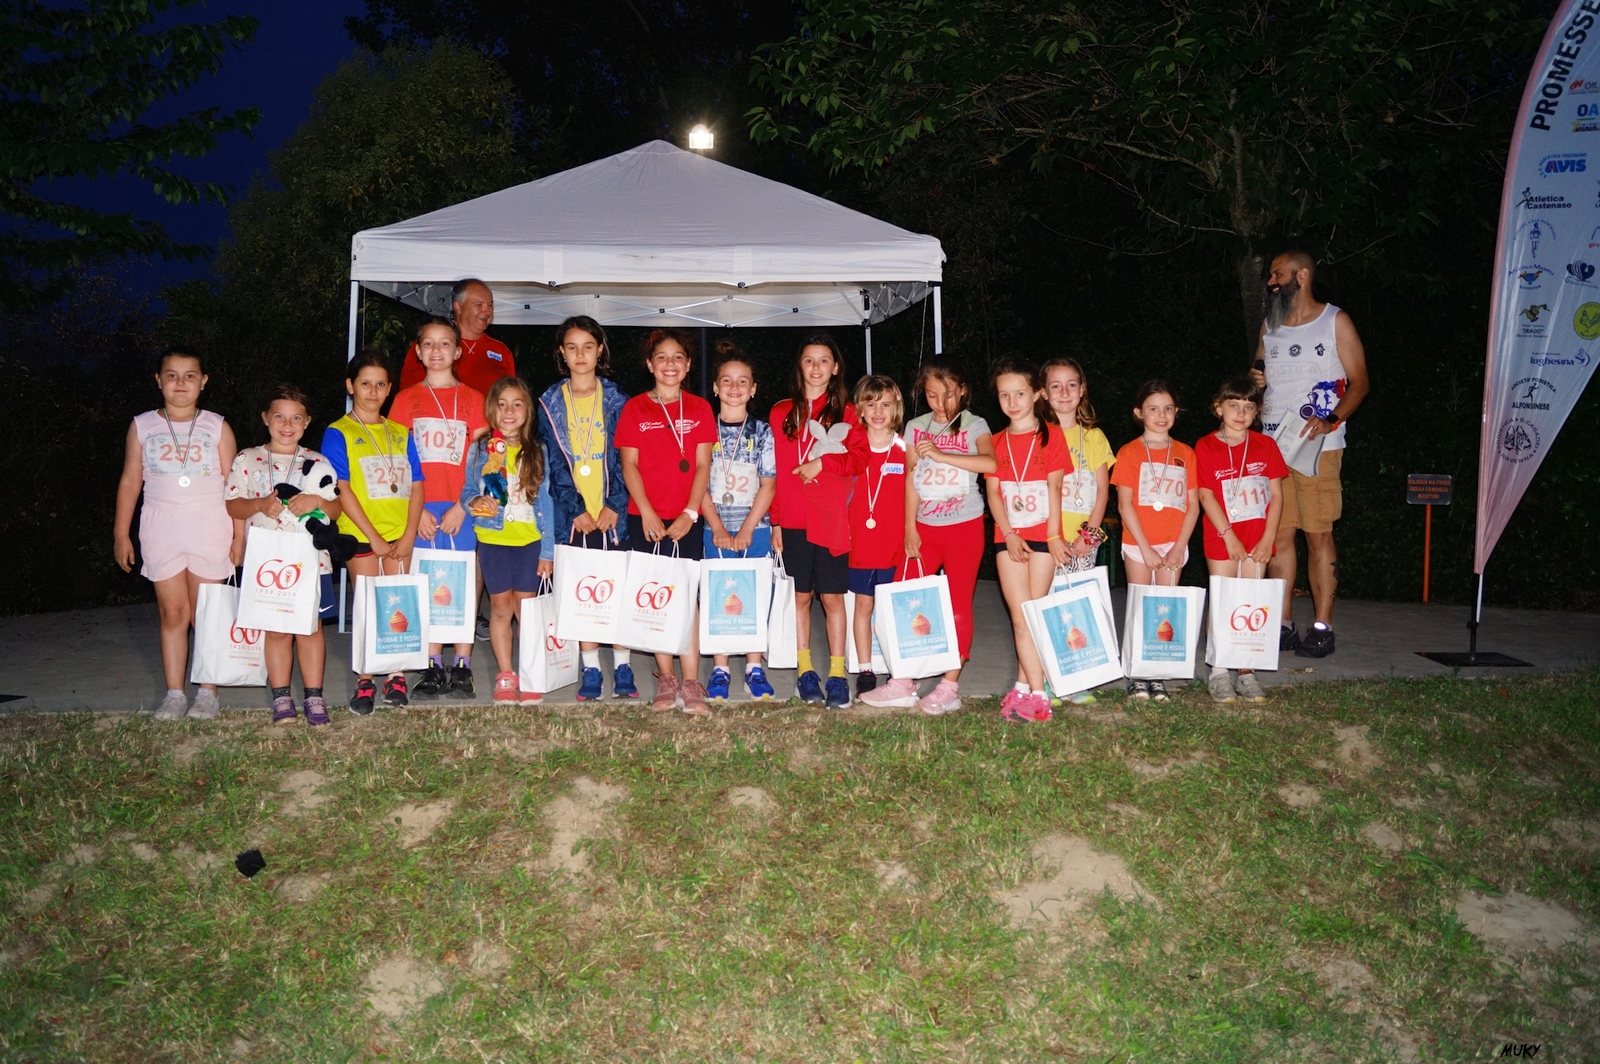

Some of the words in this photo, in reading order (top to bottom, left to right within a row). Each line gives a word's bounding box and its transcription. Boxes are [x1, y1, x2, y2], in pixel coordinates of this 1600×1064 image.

[1530, 0, 1600, 131] PROMESSE
[1545, 159, 1587, 173] AVIS
[1527, 202, 1572, 210] Castenaso
[1529, 195, 1564, 203] Atletica
[1511, 402, 1551, 411] ALFONSINESE
[421, 430, 457, 450] 102
[159, 444, 203, 463] 253
[922, 468, 960, 486] 252
[1149, 476, 1185, 498] 270
[1239, 488, 1267, 506] 111
[256, 559, 302, 590] 60
[256, 587, 297, 598] 1959-2019
[575, 575, 614, 604] 60
[635, 581, 673, 610] 60
[574, 602, 612, 610] 1959-2019
[1230, 604, 1268, 632] 60
[900, 639, 922, 648] INSIEME
[927, 636, 946, 644] FESTA!
[1058, 654, 1080, 664] INSIEME
[1086, 647, 1104, 657] FESTA!
[1090, 654, 1106, 662] SABATO
